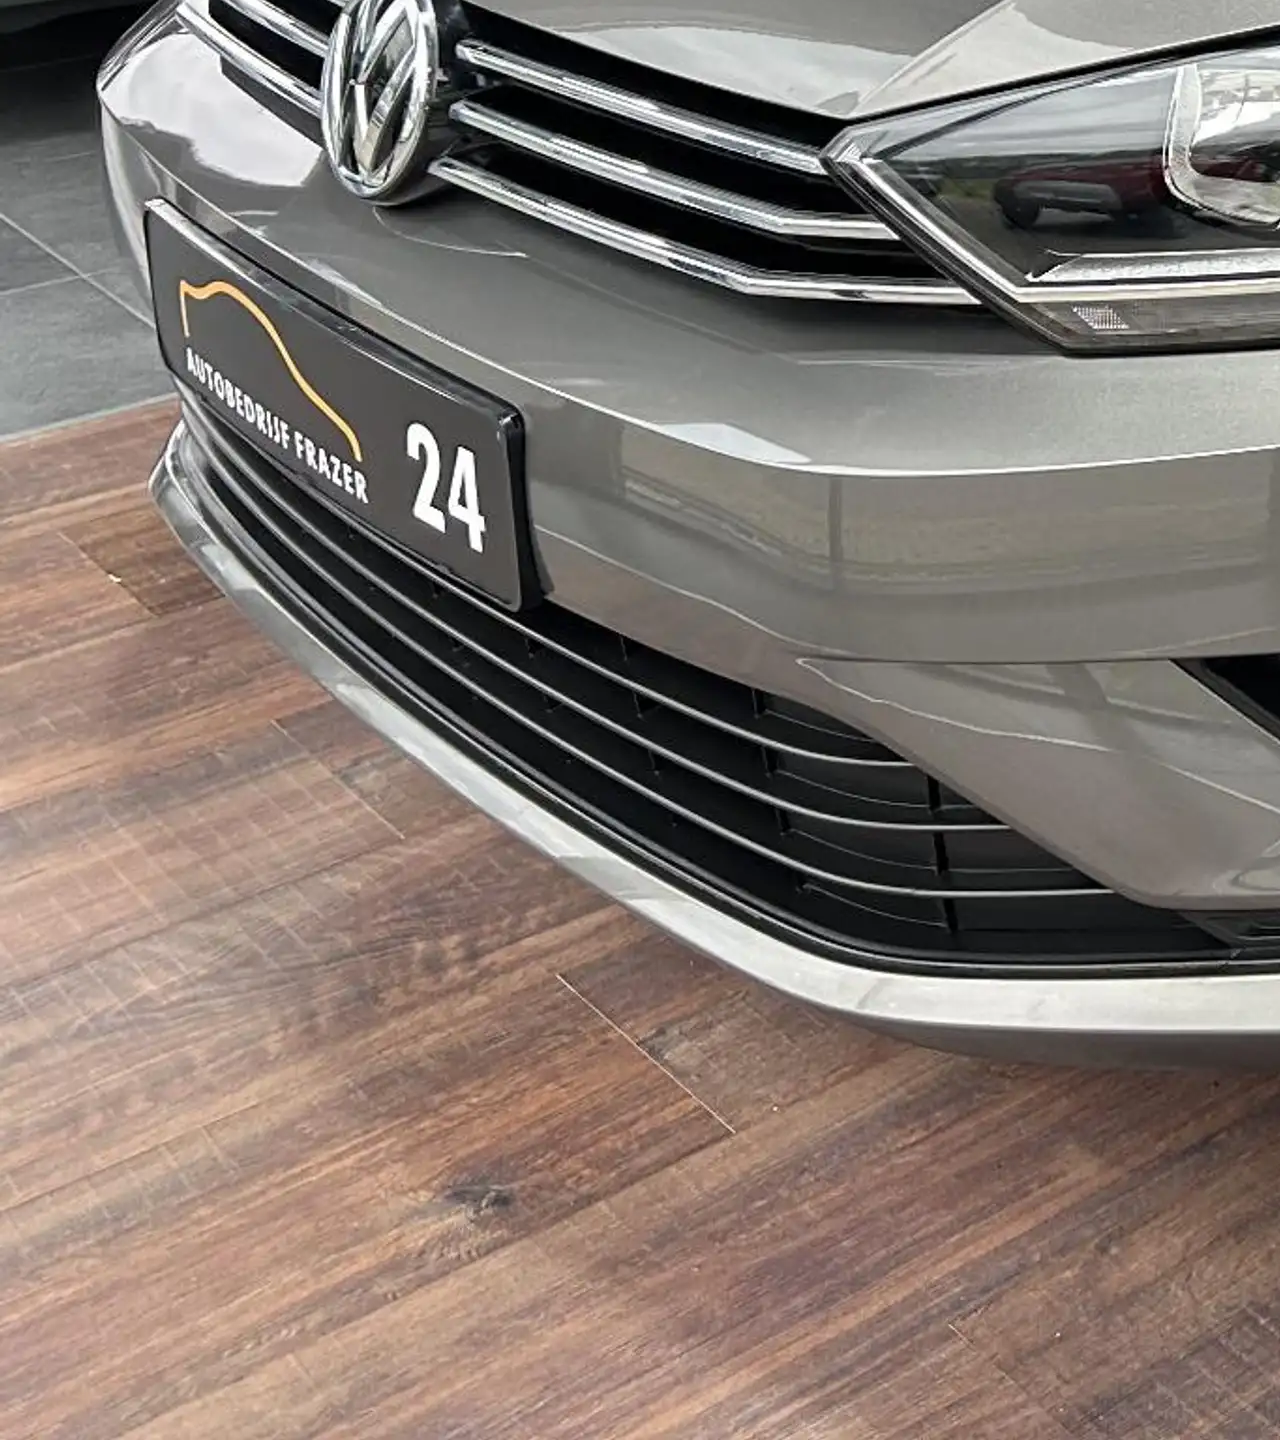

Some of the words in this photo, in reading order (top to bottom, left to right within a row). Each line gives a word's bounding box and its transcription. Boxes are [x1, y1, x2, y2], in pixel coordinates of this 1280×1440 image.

[186, 347, 290, 448] AUTOBEDRIJF
[294, 431, 369, 504] FRAZER
[405, 421, 487, 554] 24
